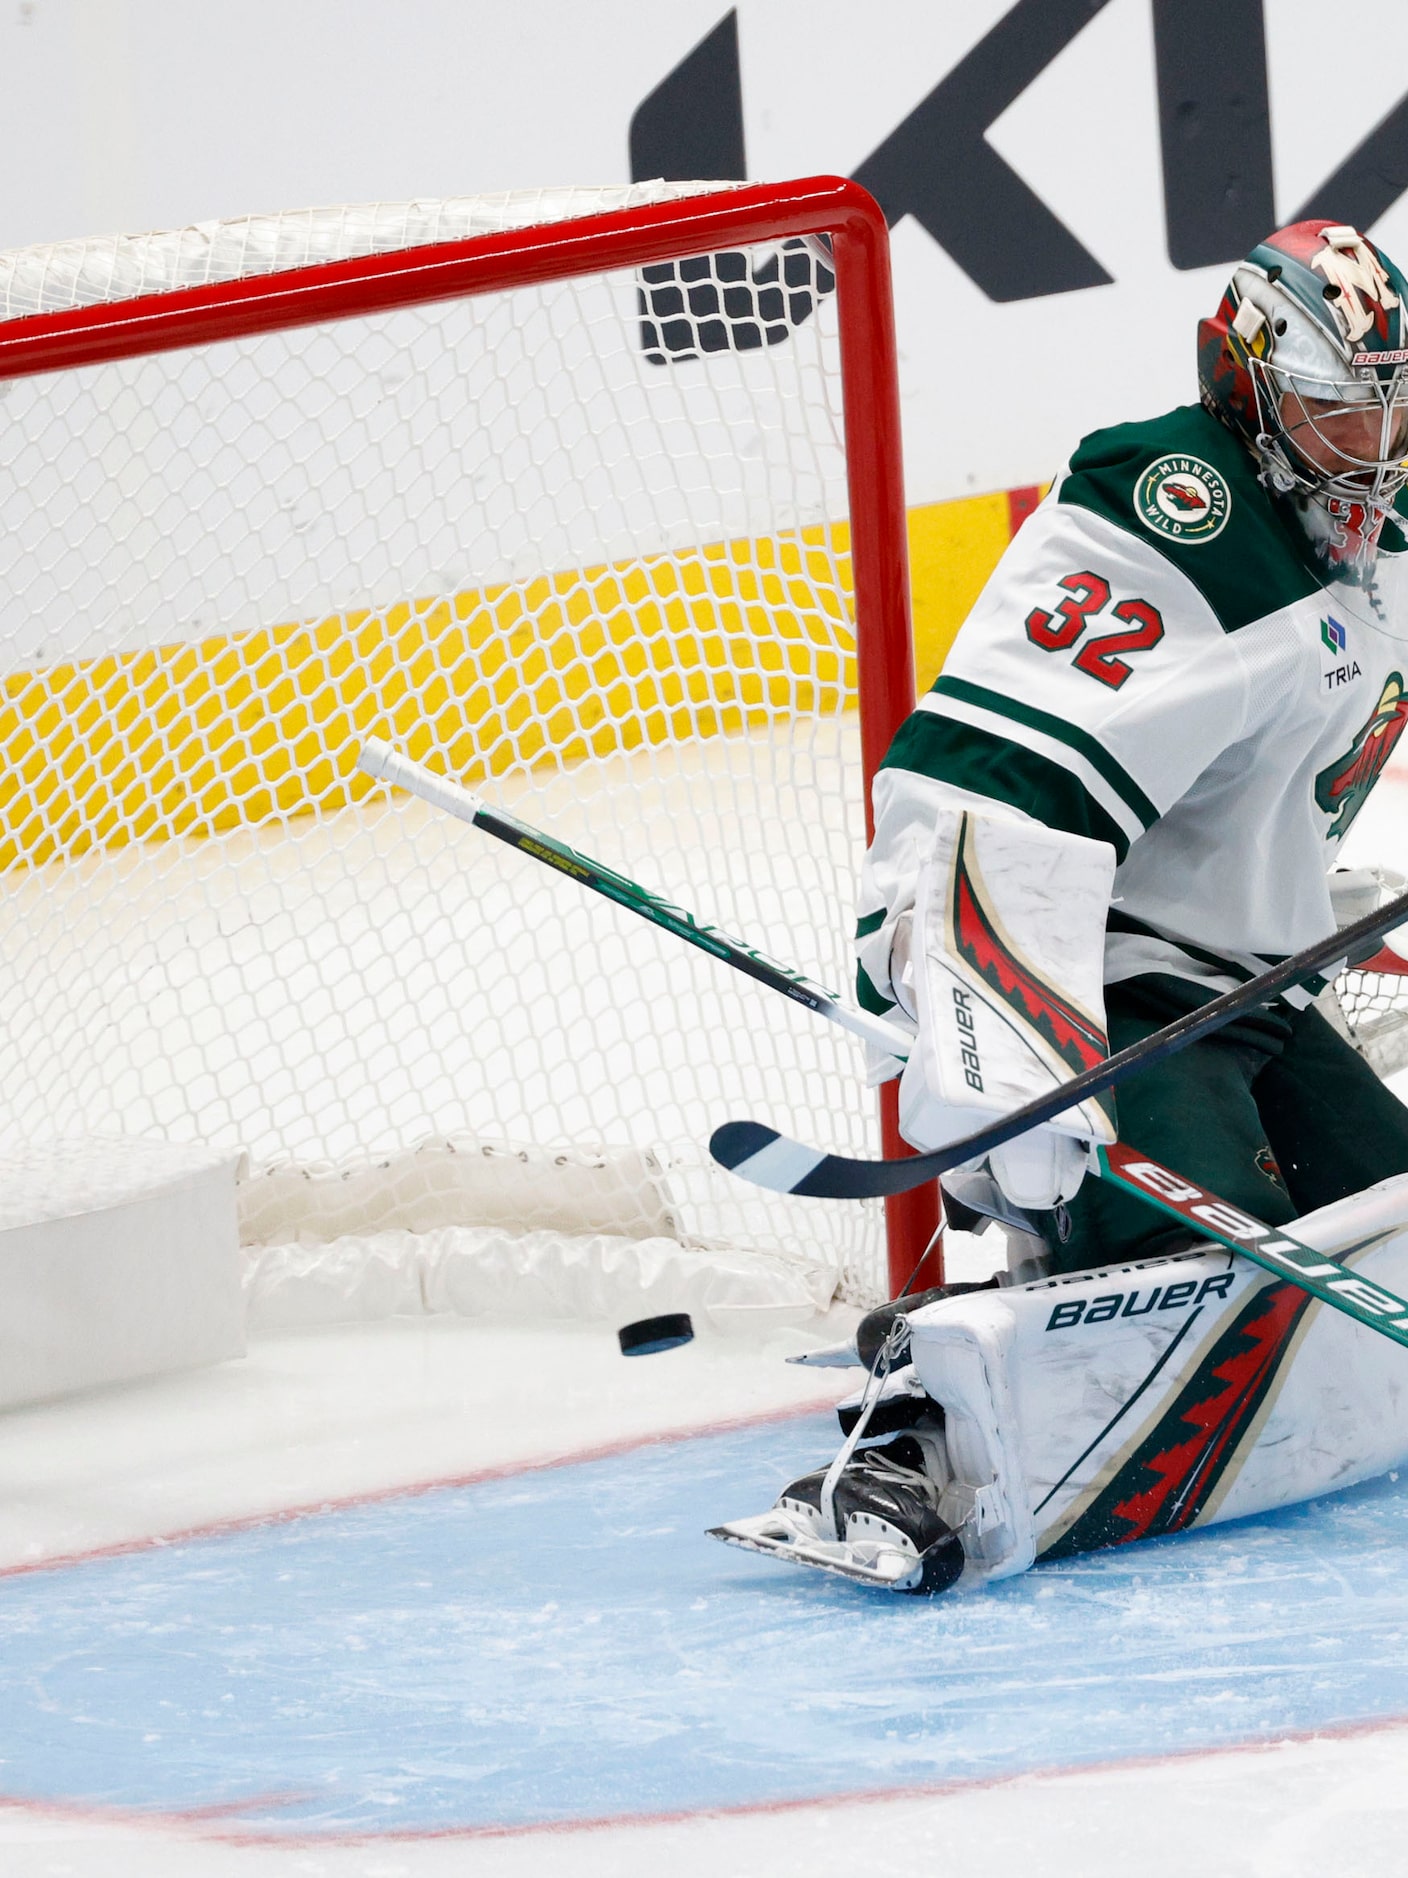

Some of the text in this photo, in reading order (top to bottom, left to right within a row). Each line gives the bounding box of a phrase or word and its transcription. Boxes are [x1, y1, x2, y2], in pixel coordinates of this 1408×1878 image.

[1158, 460, 1224, 517] MINNESOTA
[1145, 504, 1182, 534] WILD
[1025, 570, 1164, 692] 32
[1324, 661, 1362, 690] TRIA
[952, 987, 984, 1094] BAUER
[1045, 1272, 1236, 1332] BAUER
